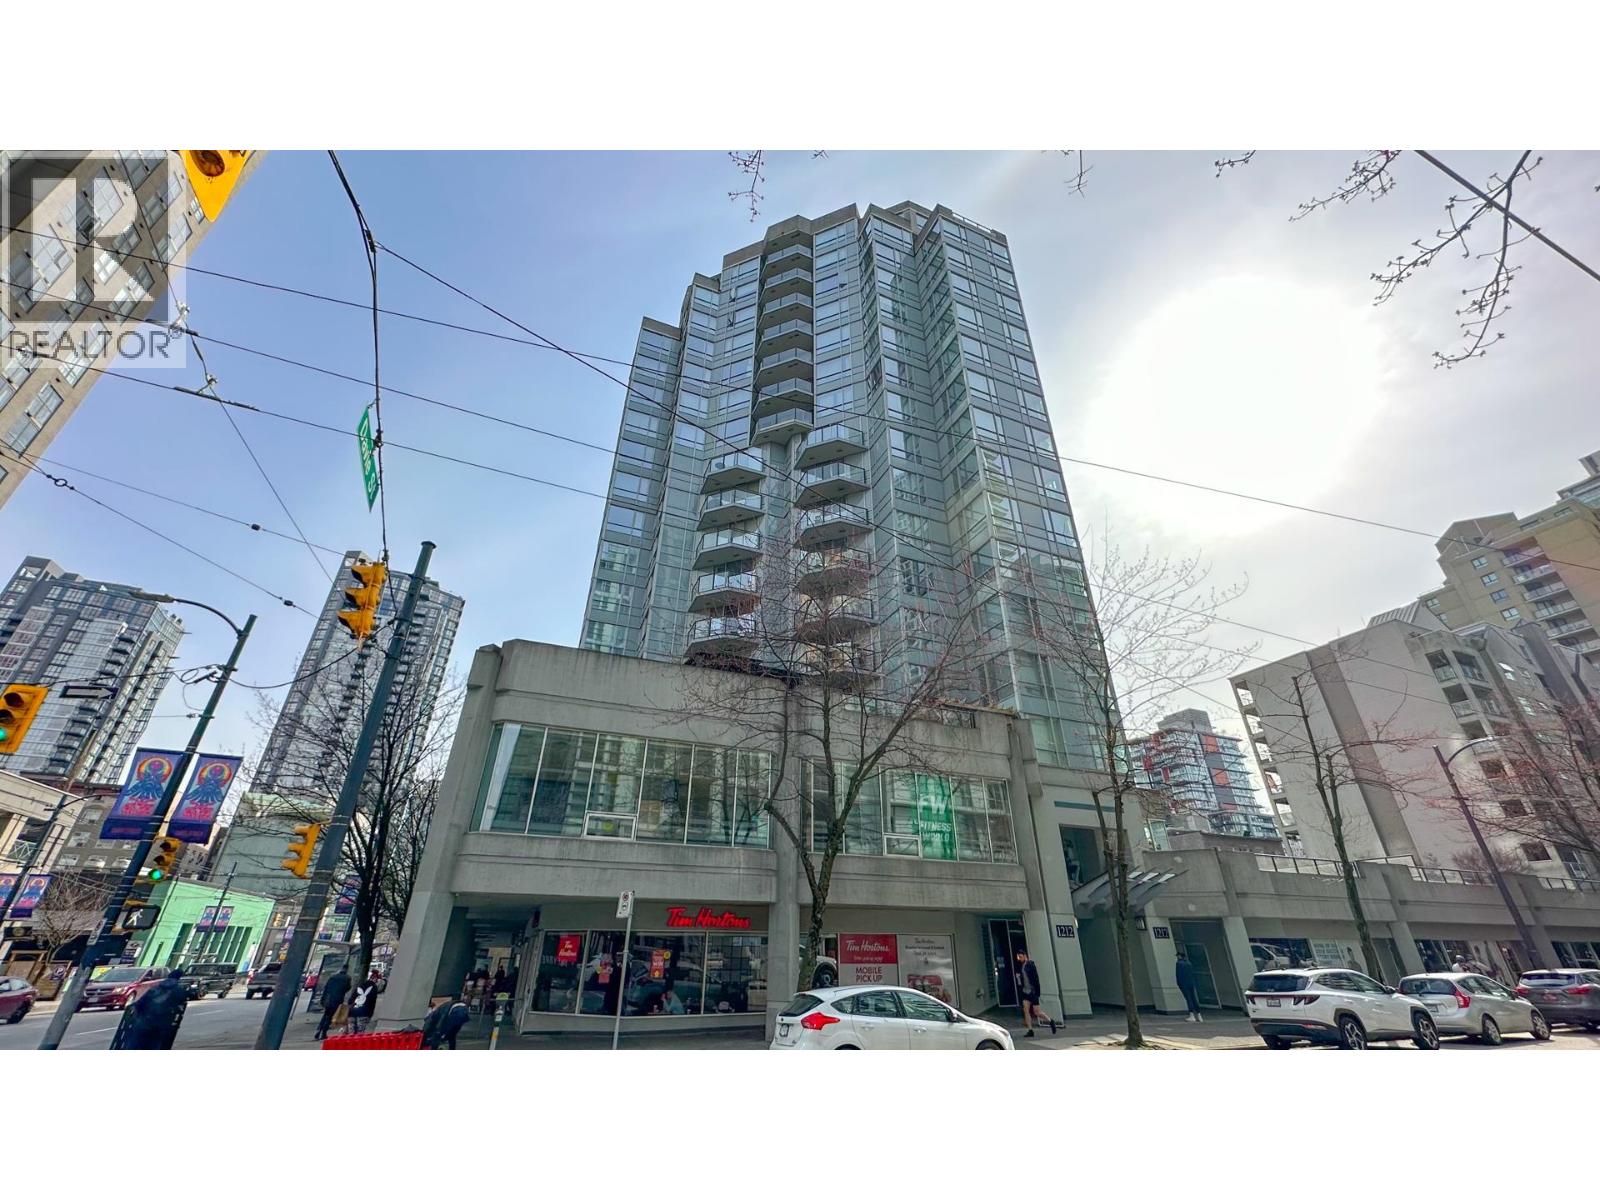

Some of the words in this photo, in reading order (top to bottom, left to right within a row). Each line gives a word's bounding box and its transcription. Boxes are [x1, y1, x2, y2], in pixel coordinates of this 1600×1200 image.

[920, 821, 951, 831] FITNESS
[668, 907, 693, 928] Tim
[696, 907, 750, 928] Hortons
[1057, 926, 1074, 937] 1212
[846, 940, 860, 952] Tim
[861, 939, 890, 952] Hortons
[856, 966, 883, 974] MOBILE
[856, 974, 872, 983] PICK
[873, 974, 883, 983] UP
